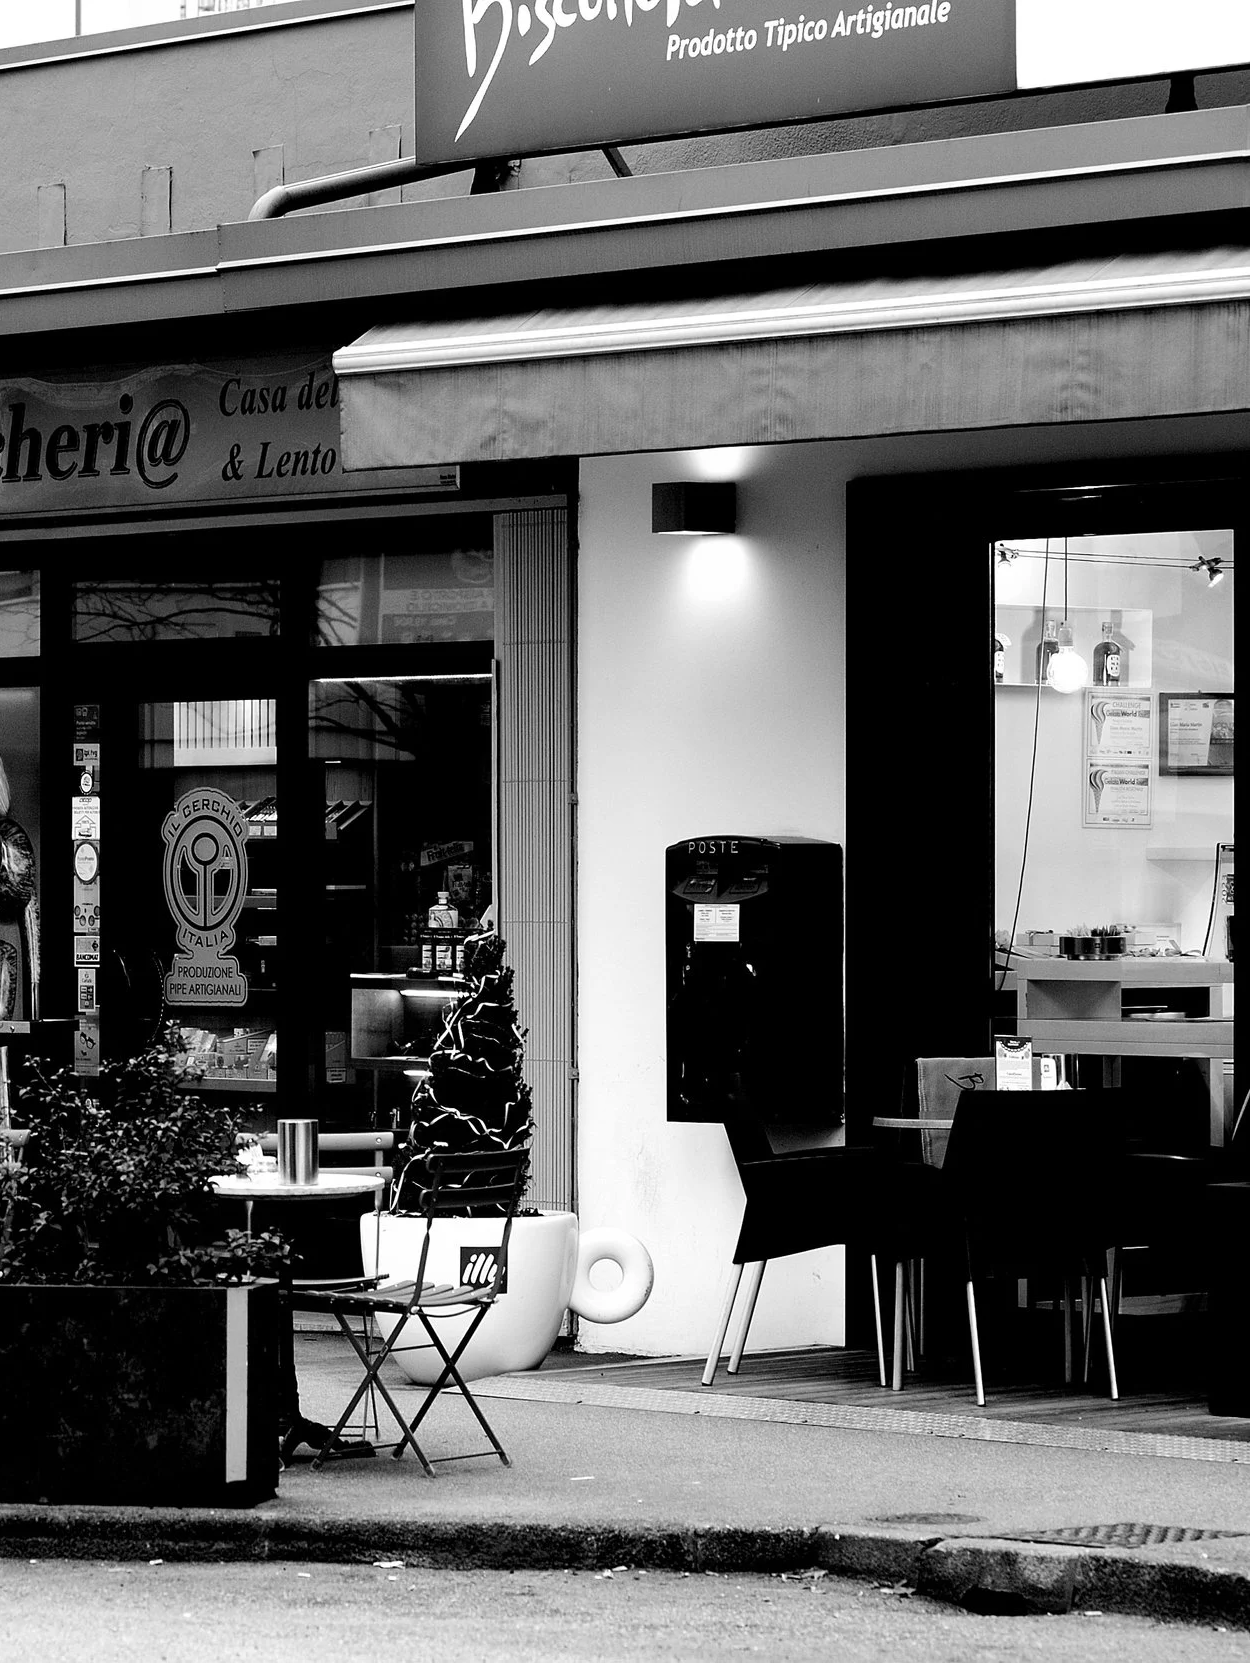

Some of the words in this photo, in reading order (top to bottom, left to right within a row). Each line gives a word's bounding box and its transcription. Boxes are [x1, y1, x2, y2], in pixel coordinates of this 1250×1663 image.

[666, 27, 758, 61] Prodotto
[764, 15, 828, 51] Tipico
[831, 0, 951, 39] Artigianale
[218, 377, 288, 417] Casa
[221, 442, 244, 482] &
[254, 441, 337, 480] Lento
[168, 821, 181, 838] IL
[182, 798, 244, 838] CERCHIO
[688, 840, 739, 854] POSTE
[182, 927, 230, 948] ITALIA
[177, 966, 234, 979] PRODUZIONE
[169, 982, 187, 996] PIPE
[188, 983, 241, 996] ARTIGIANALI
